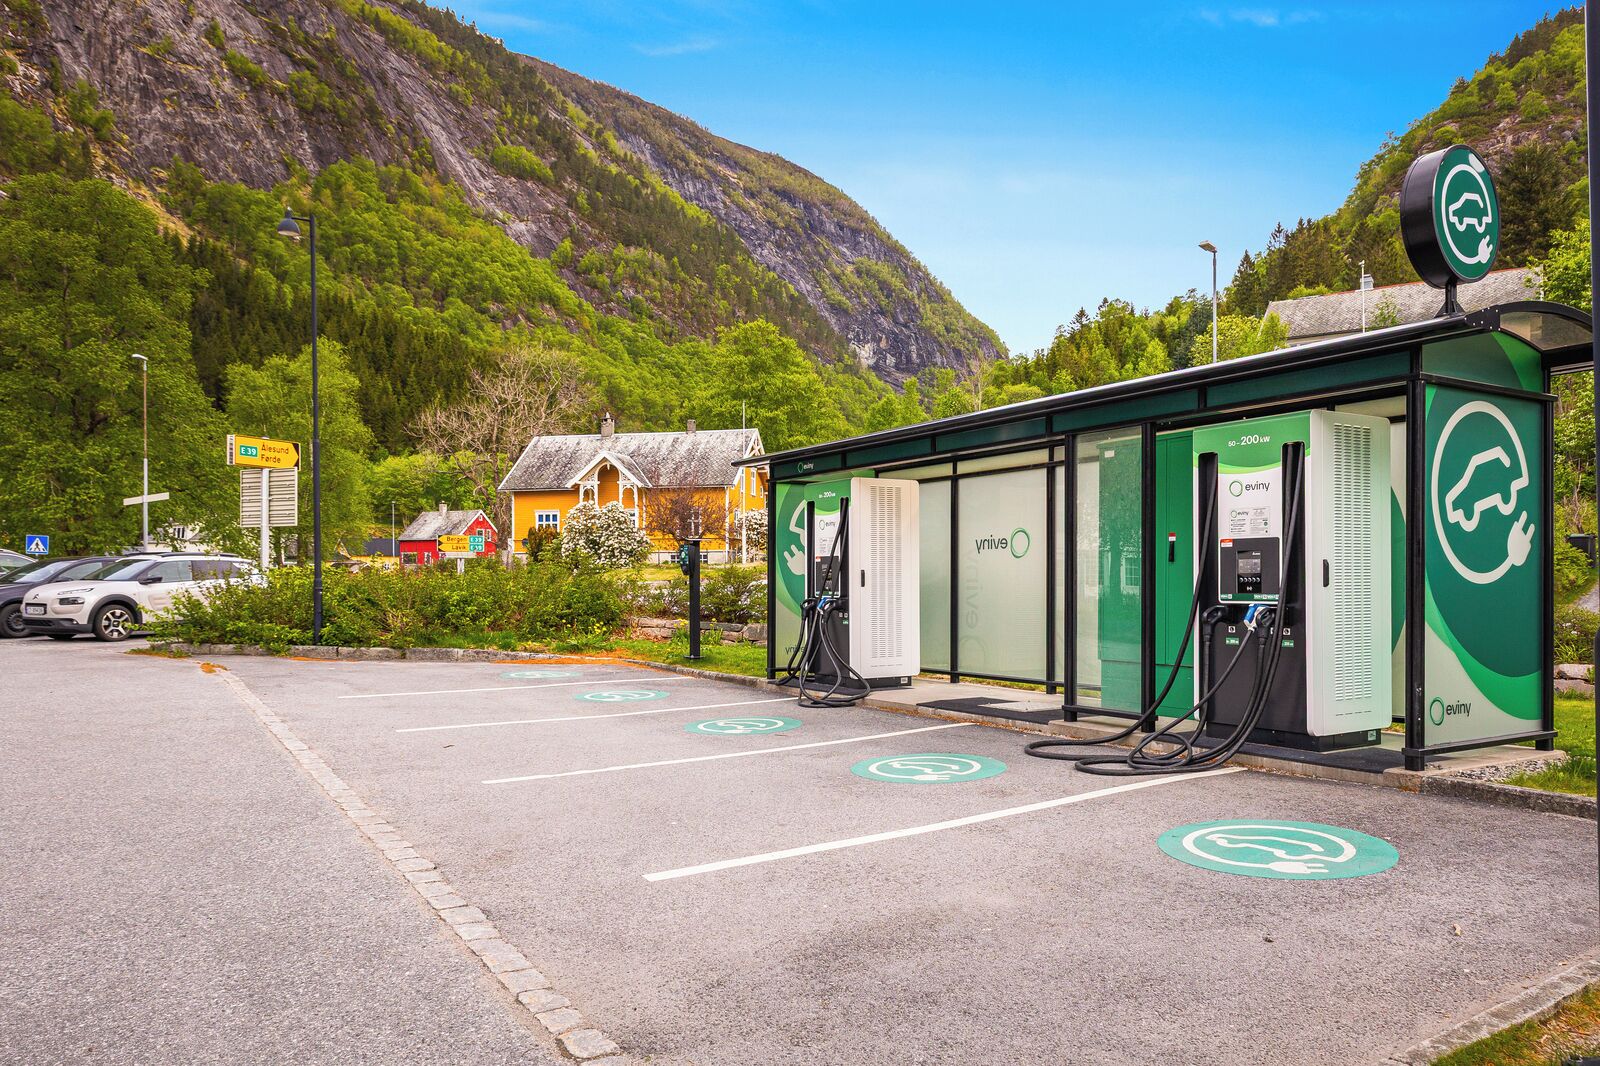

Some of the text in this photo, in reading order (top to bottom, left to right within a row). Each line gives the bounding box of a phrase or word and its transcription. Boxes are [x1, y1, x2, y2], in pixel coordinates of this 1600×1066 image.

[247, 447, 257, 455] 39
[261, 442, 289, 454] Ålesund
[261, 454, 281, 463] Førde
[1245, 481, 1270, 491] eviny
[1446, 700, 1471, 717] eviny
